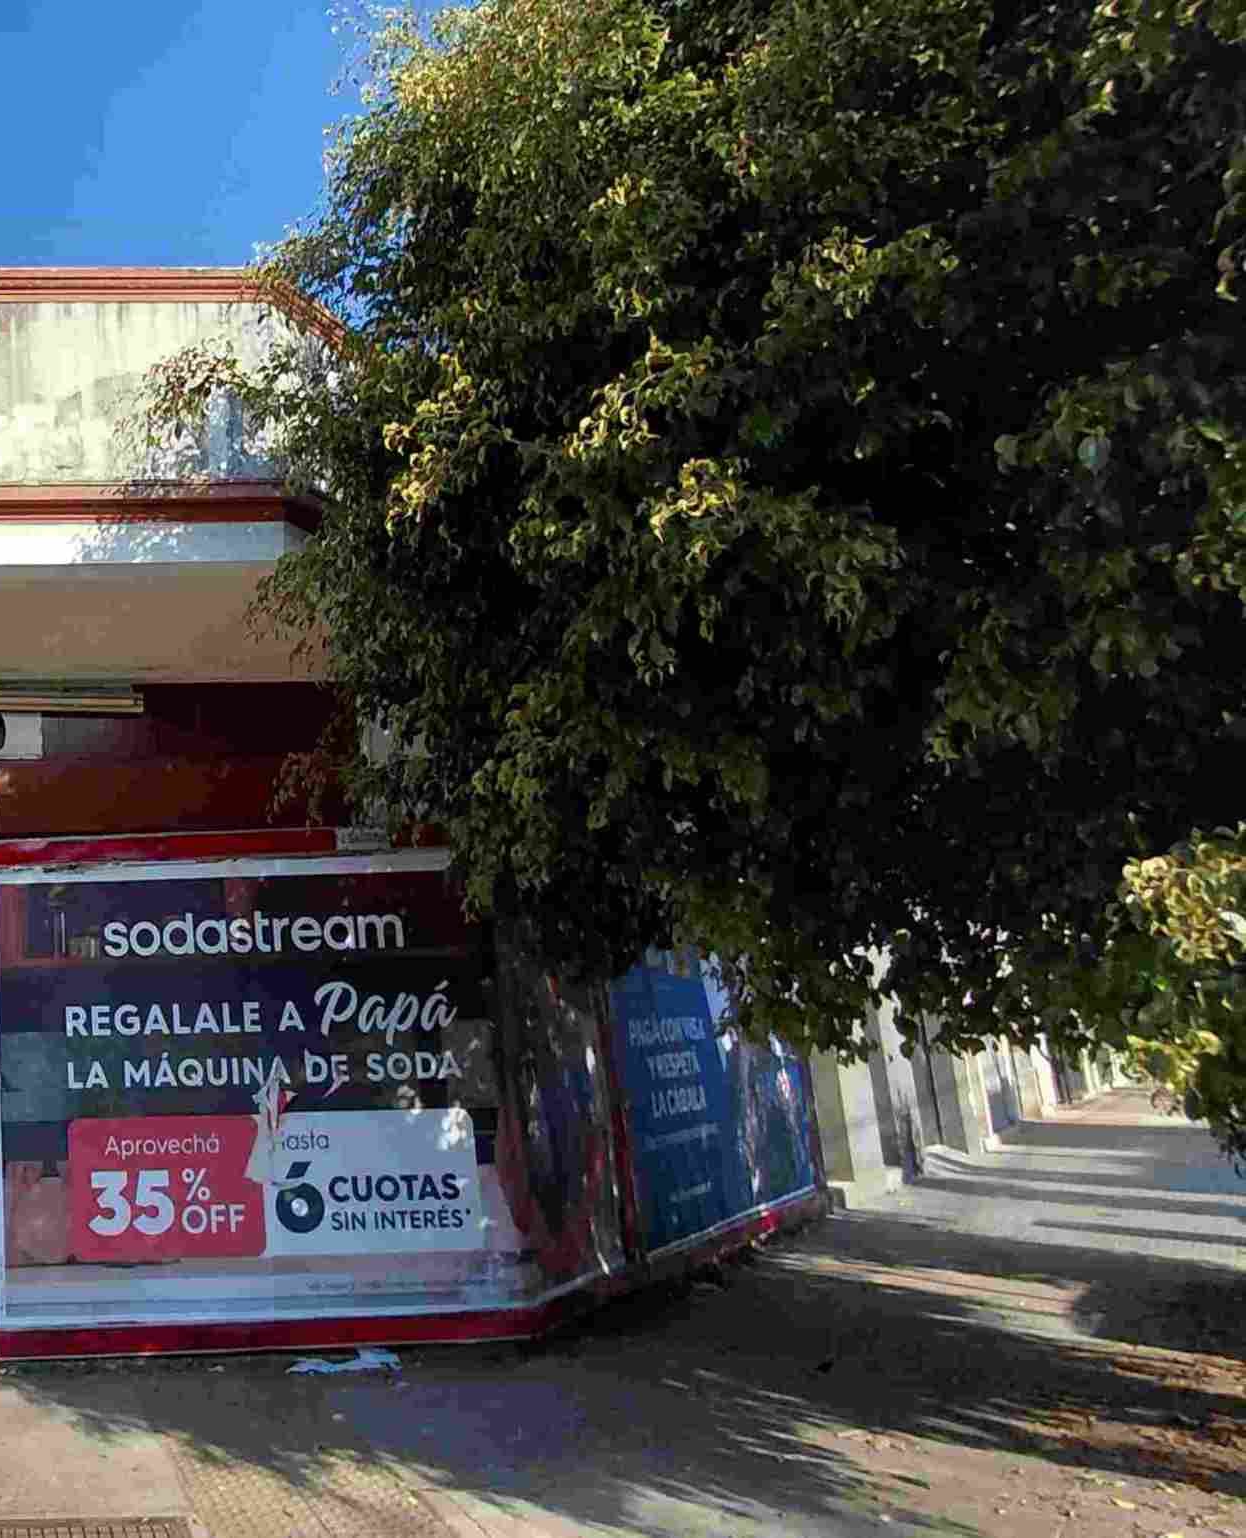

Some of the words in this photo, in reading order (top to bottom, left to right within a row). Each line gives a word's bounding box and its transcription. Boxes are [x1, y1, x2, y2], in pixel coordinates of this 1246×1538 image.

[104, 911, 405, 957] sodastream
[65, 1000, 262, 1037] REGALALE
[278, 1000, 306, 1032] A
[314, 979, 458, 1046] Papá
[67, 1060, 110, 1089] LA
[123, 1051, 291, 1089] MÁQUINA
[305, 1050, 351, 1084] DE
[366, 1050, 463, 1082] SODA
[104, 1132, 221, 1161] Aprovechá
[88, 1169, 176, 1237] 35
[275, 1160, 326, 1234] 6
[328, 1172, 461, 1203] CUOTAS
[181, 1203, 246, 1235] OFF
[331, 1209, 367, 1232] SIN
